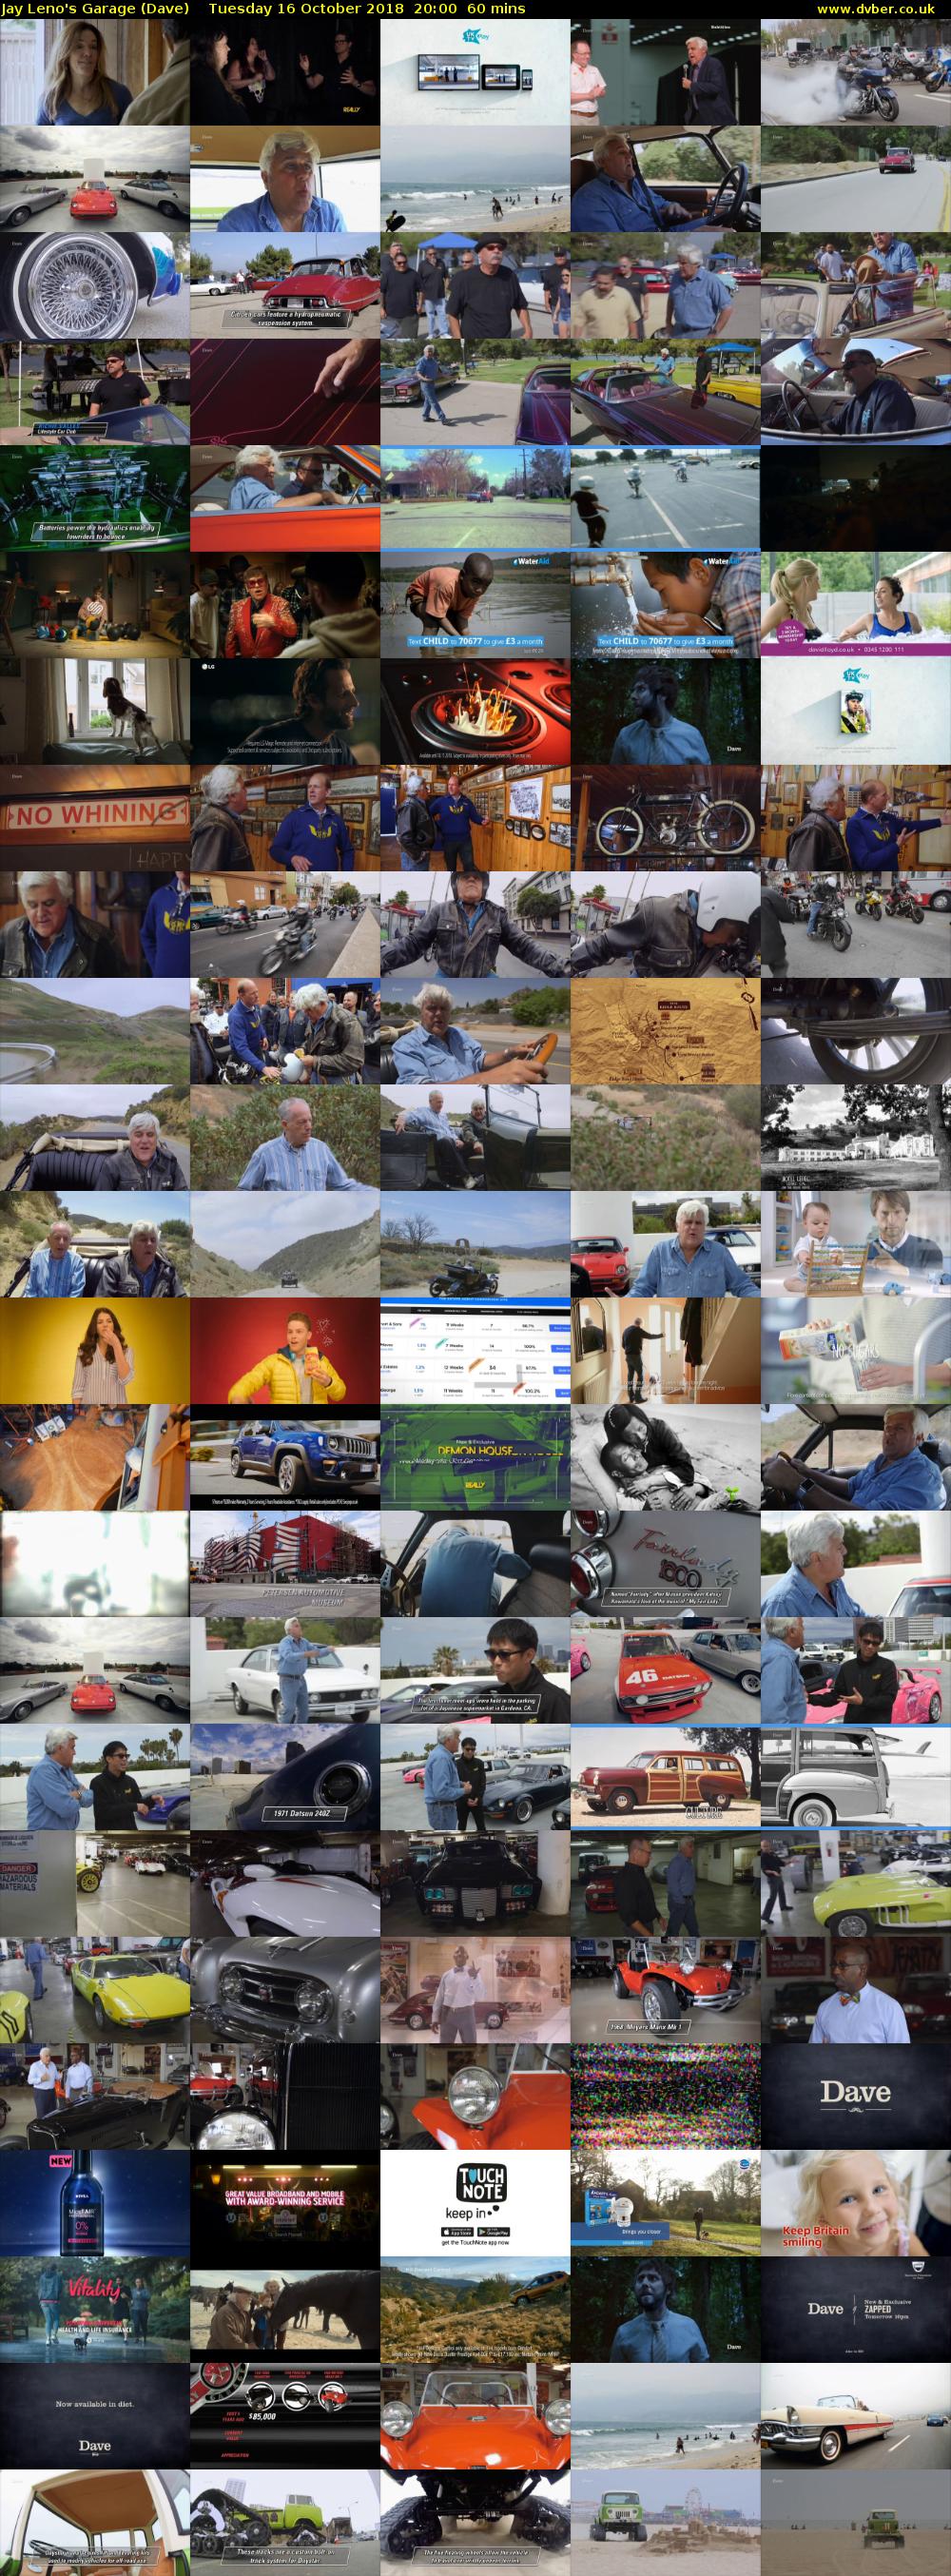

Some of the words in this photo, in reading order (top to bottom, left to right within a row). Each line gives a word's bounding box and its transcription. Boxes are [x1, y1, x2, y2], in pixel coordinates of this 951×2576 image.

[17, 806, 52, 826] NO
[62, 802, 177, 824] WHINING
[626, 1669, 659, 1685] 46
[0, 1883, 36, 1892] MATERIALS
